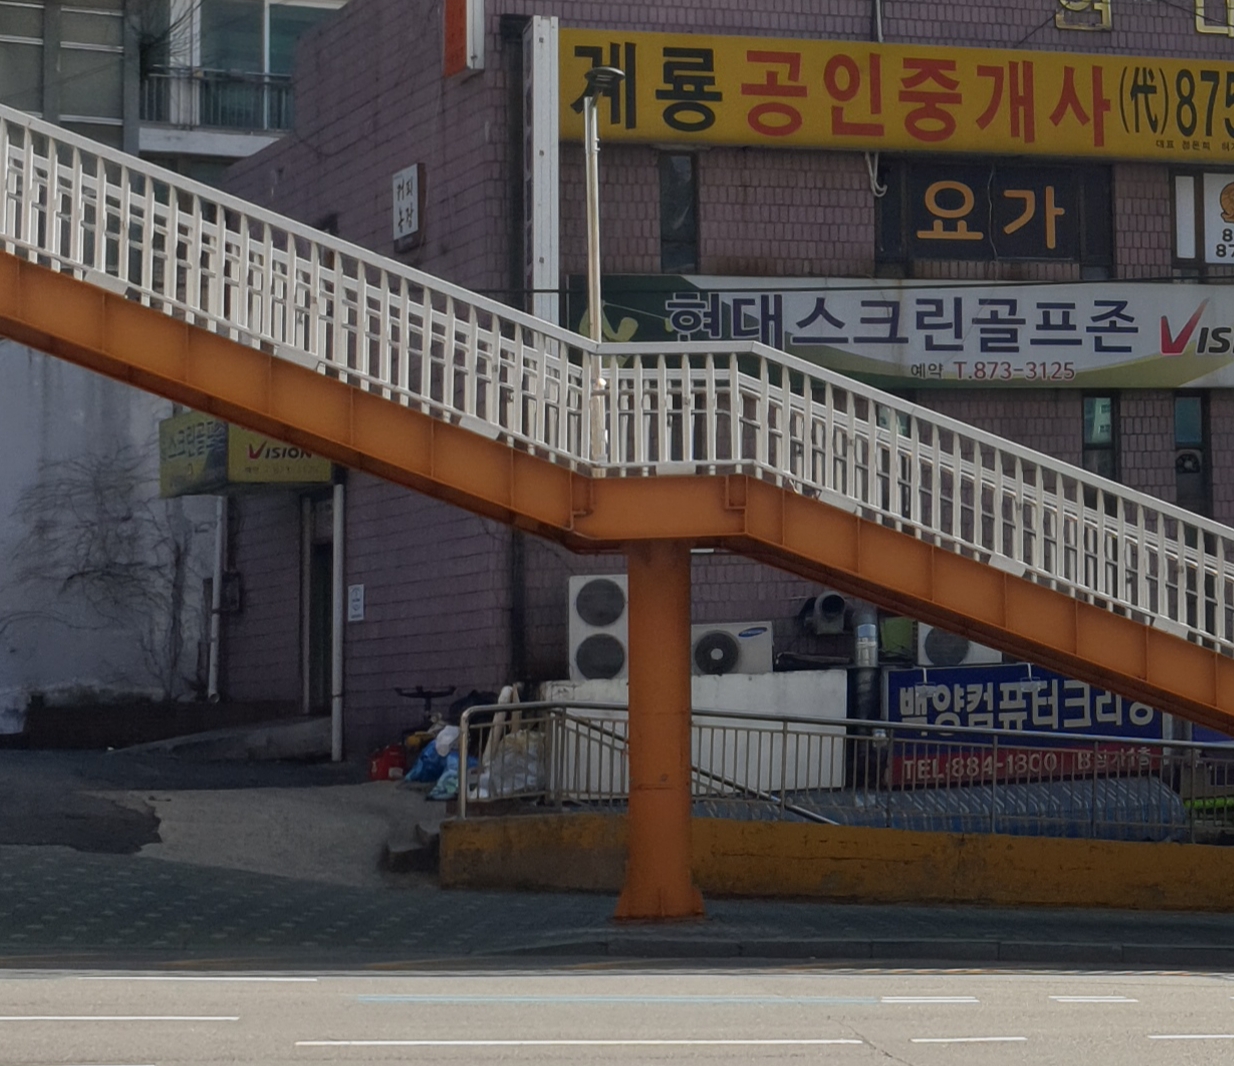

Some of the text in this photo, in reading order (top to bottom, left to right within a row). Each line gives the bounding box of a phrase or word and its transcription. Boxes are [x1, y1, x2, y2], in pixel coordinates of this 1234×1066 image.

[916, 180, 1066, 250] 요가
[910, 361, 1077, 381] 예약 T.873-3125
